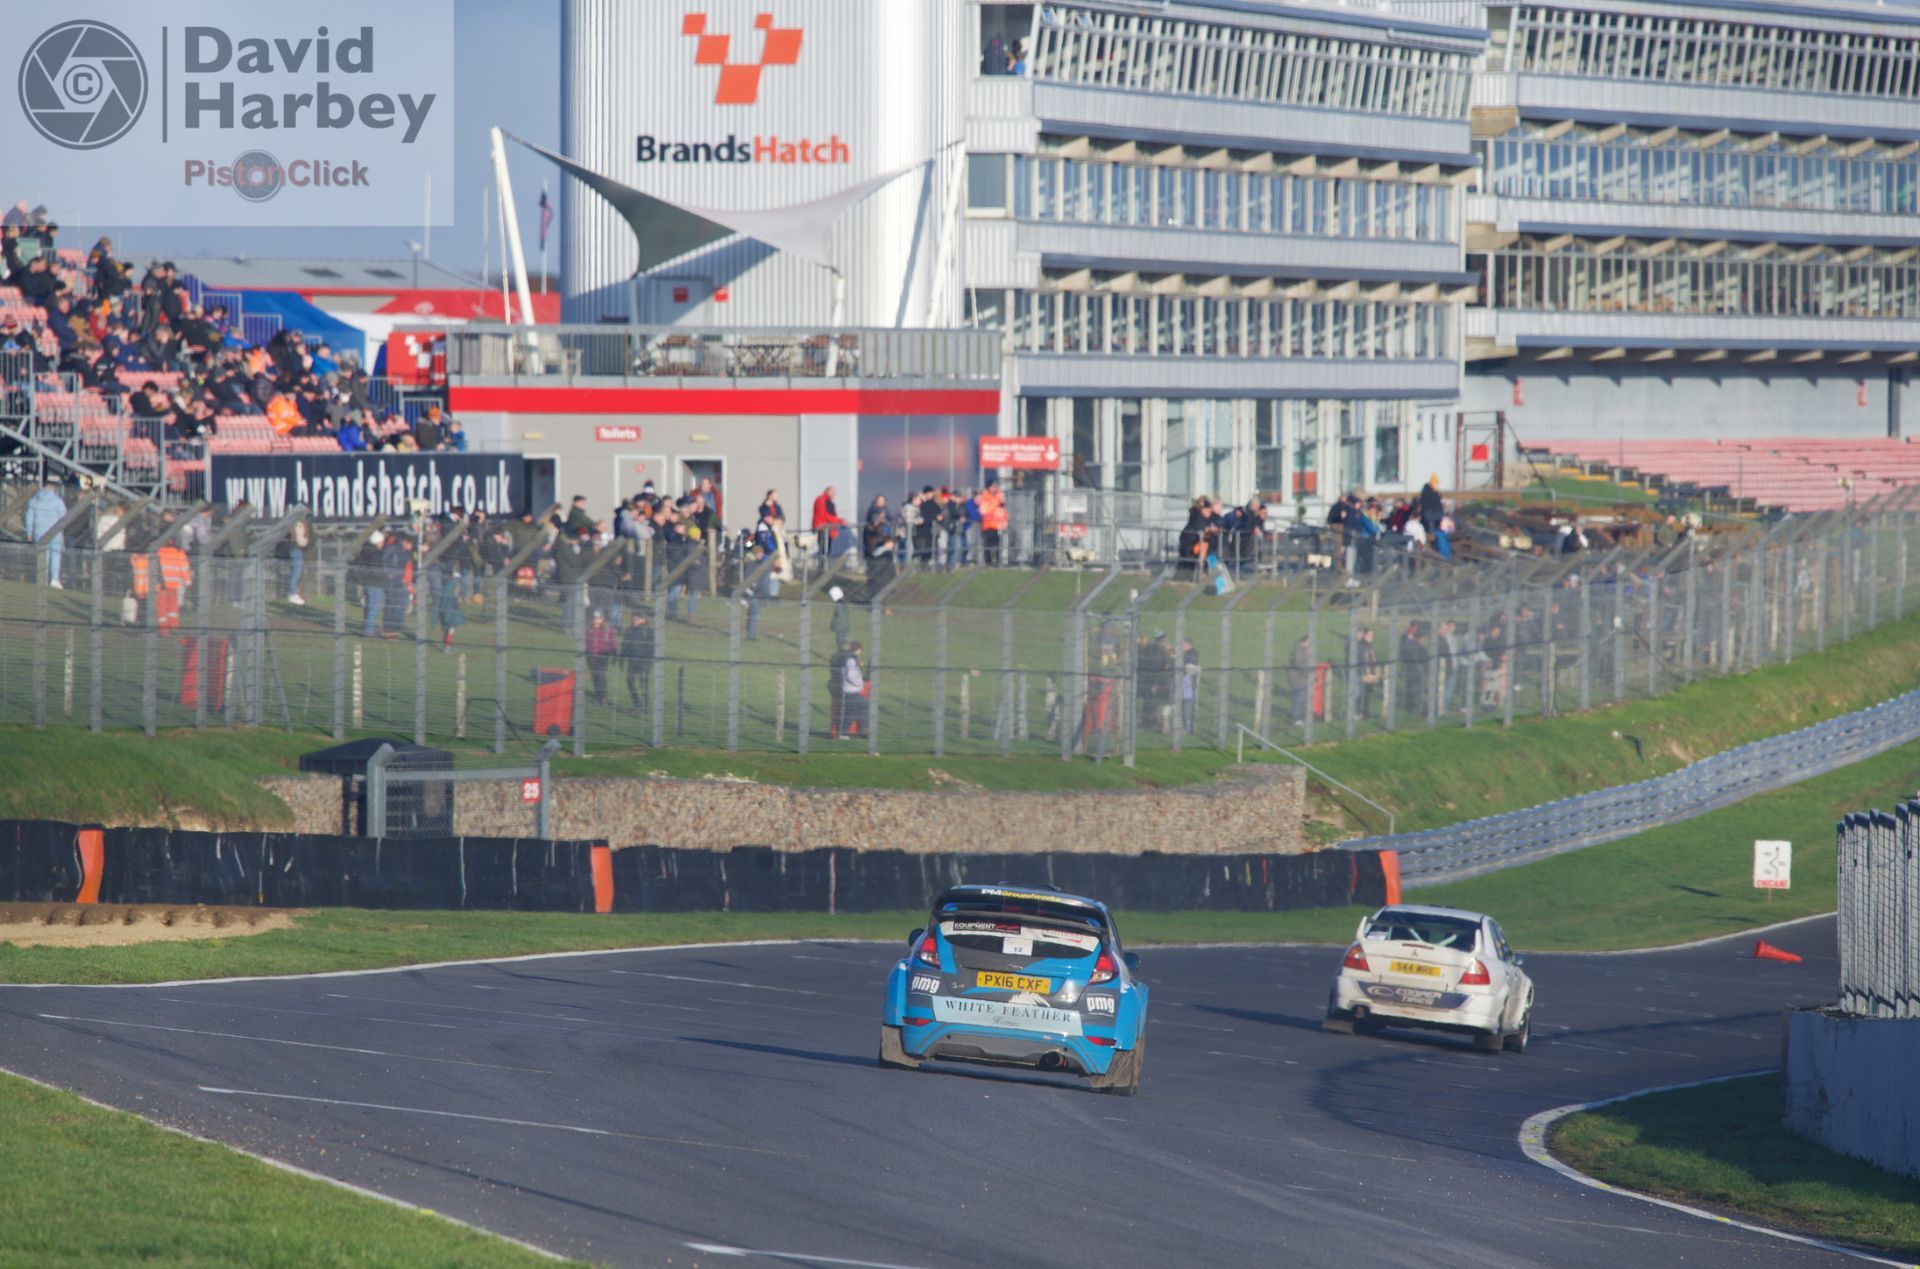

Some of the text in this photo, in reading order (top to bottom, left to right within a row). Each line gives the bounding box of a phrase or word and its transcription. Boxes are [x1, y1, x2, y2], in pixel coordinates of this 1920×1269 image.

[636, 134, 850, 164] BrandsHatch
[599, 428, 638, 439] Toilets
[226, 459, 512, 519] www.brandshatch.co.uk
[523, 782, 540, 799] 25
[911, 976, 940, 994] pmg
[983, 975, 1044, 992] PX16 CXF
[945, 1000, 1072, 1023] WHITE FEATHER
[1087, 996, 1114, 1015] pmg
